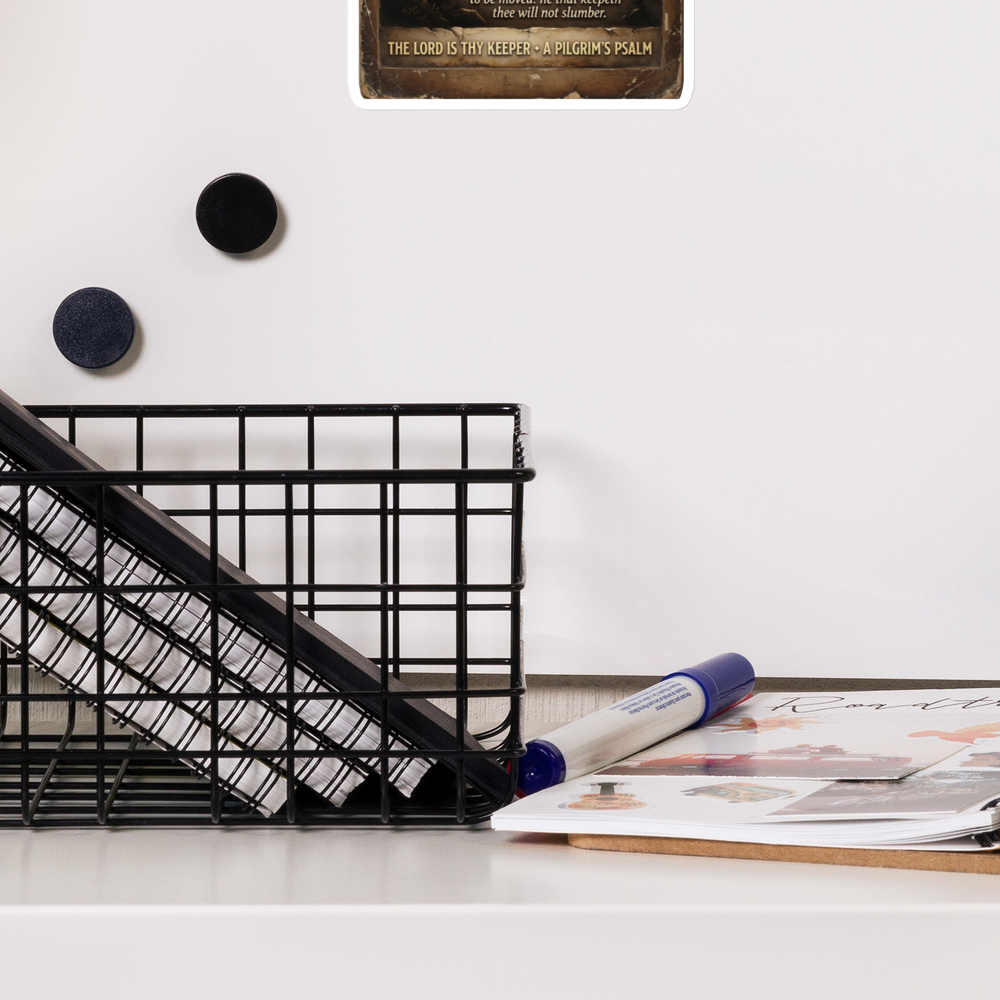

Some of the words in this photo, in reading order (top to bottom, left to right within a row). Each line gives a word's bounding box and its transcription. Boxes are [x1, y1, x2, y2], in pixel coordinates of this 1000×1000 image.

[492, 6, 516, 18] thee
[518, 6, 539, 18] will
[541, 7, 560, 18] not
[561, 6, 607, 18] slumber.
[388, 41, 410, 56] THE
[414, 41, 444, 56] LORD
[446, 41, 458, 56] IS
[460, 41, 484, 56] THY
[487, 41, 531, 56] KEEPER
[542, 41, 552, 56] A
[554, 41, 611, 56] PILGRIM'S
[614, 41, 653, 56] PSALM
